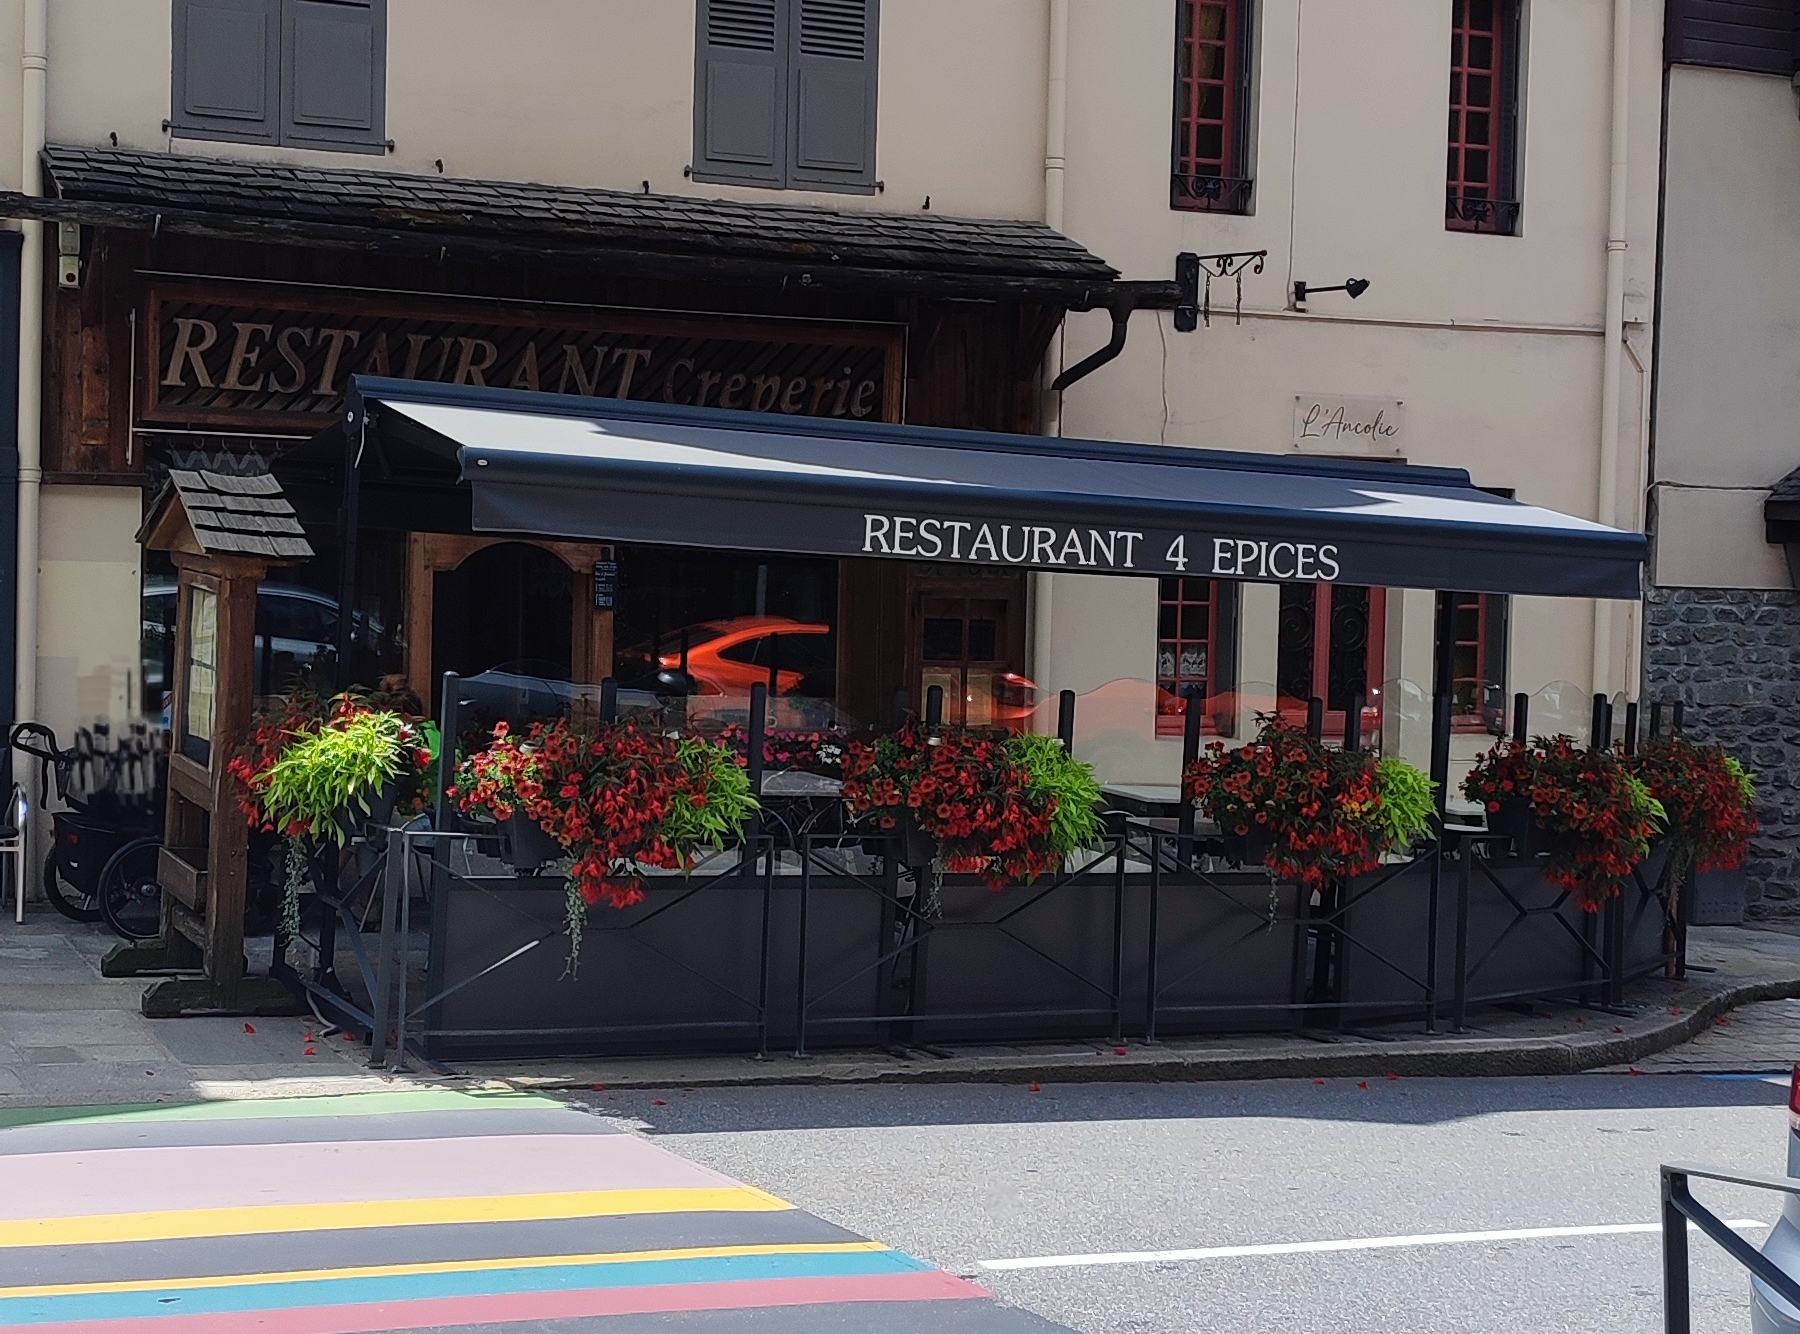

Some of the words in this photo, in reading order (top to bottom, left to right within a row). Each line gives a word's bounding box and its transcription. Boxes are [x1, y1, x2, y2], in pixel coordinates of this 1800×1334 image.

[160, 318, 651, 400] RESTAURANT
[1300, 403, 1399, 441] L'Ancolie
[861, 514, 1143, 567] RESTAURANT
[1165, 534, 1189, 571] 4
[1212, 538, 1339, 581] EPICES
